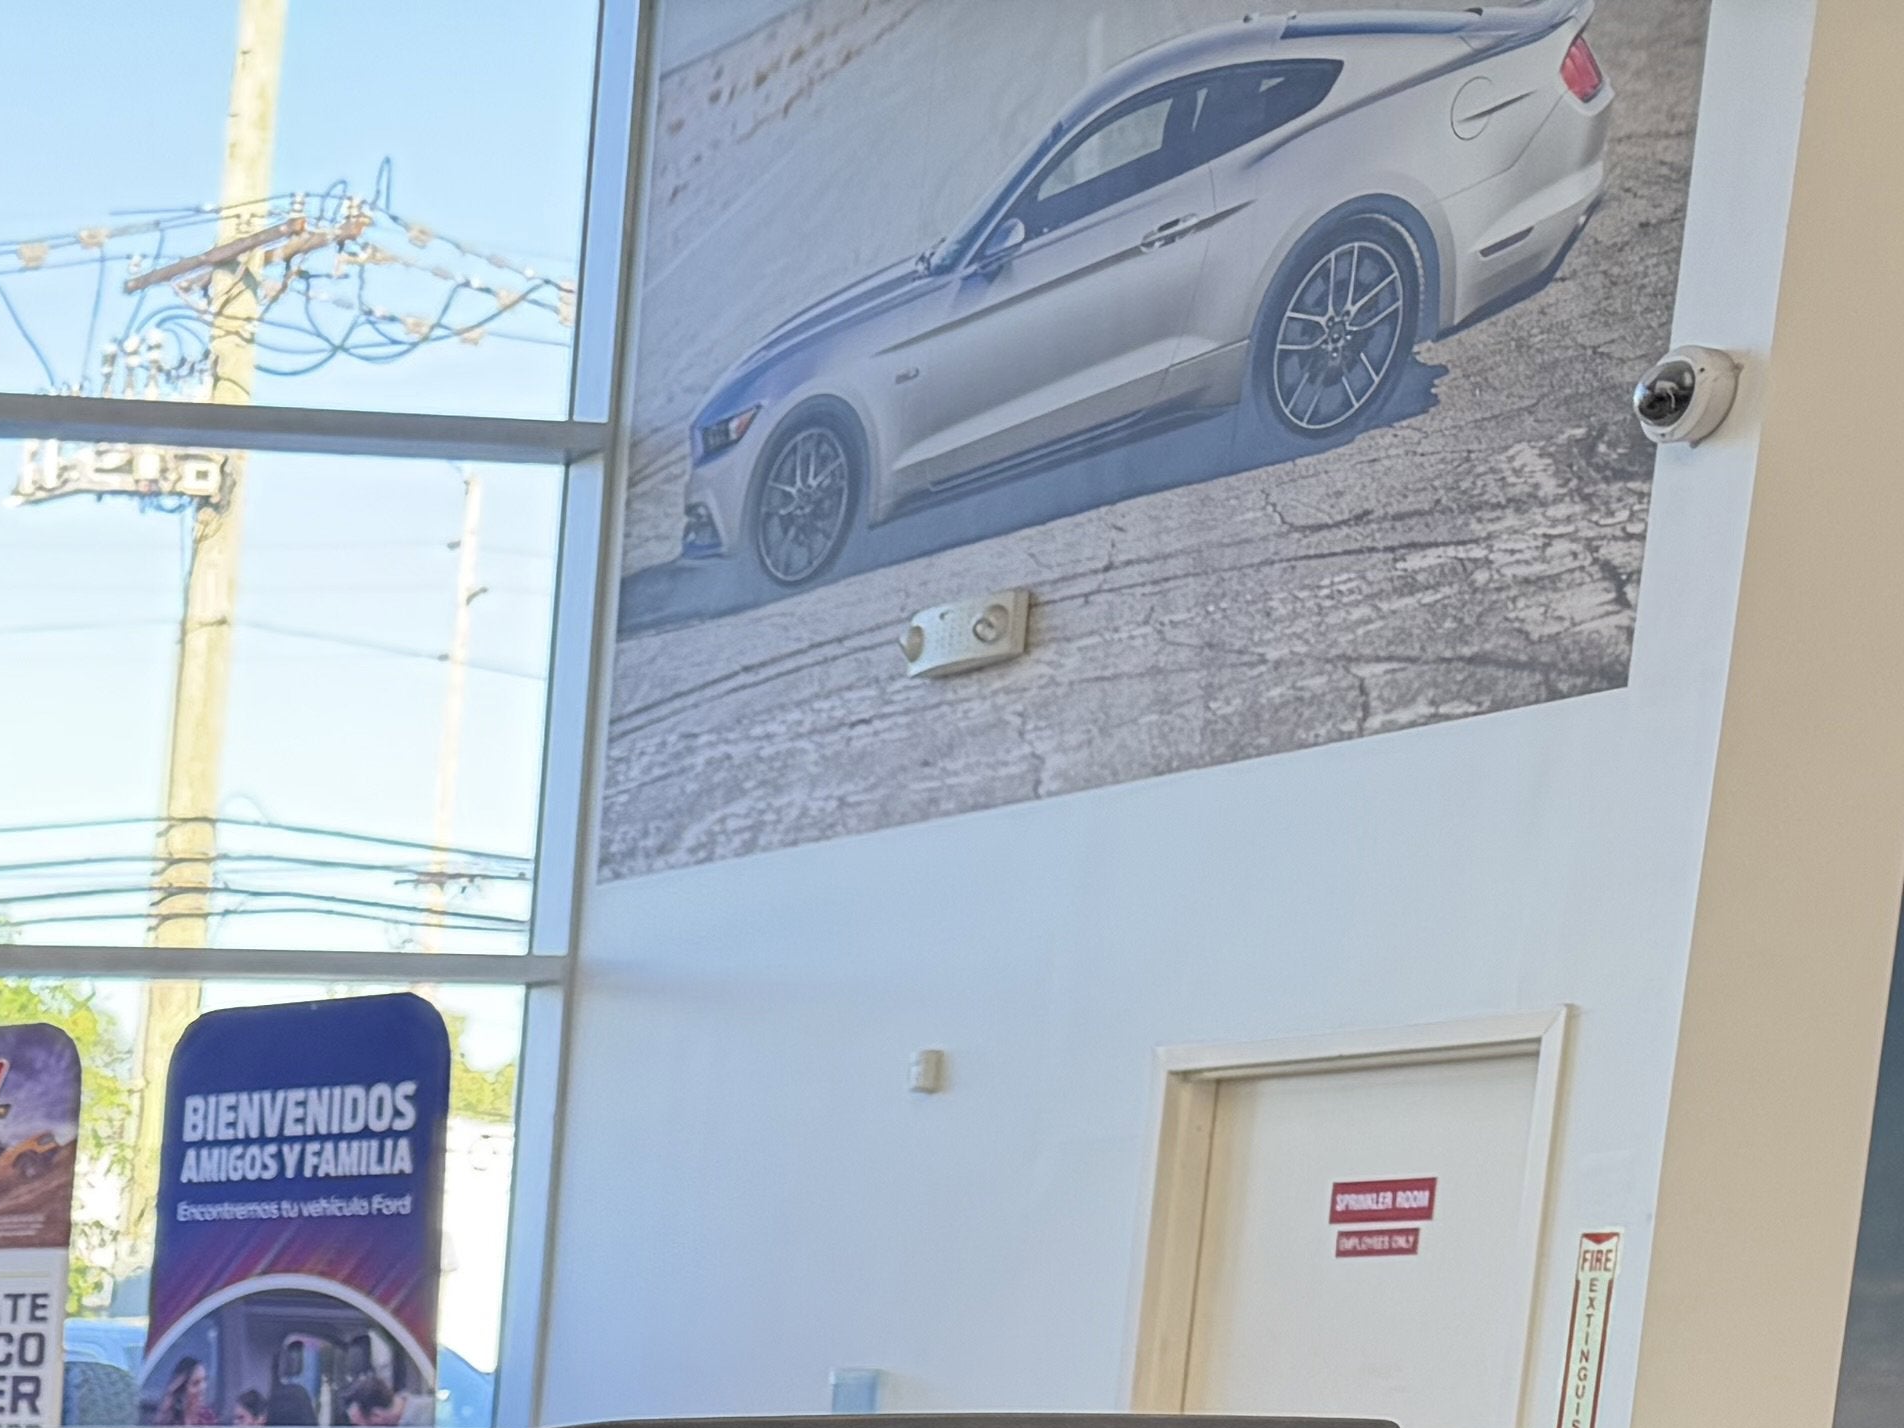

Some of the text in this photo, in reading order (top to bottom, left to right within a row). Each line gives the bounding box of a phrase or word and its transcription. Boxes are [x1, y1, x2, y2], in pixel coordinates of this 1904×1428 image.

[182, 1080, 418, 1143] BIENVENIDOS
[181, 1137, 413, 1183] AMIGOS Y FAMILIA
[176, 1200, 280, 1222] Encontremos
[281, 1198, 300, 1219] tu
[370, 1193, 413, 1216] Ford
[1580, 1249, 1613, 1272] FIRE
